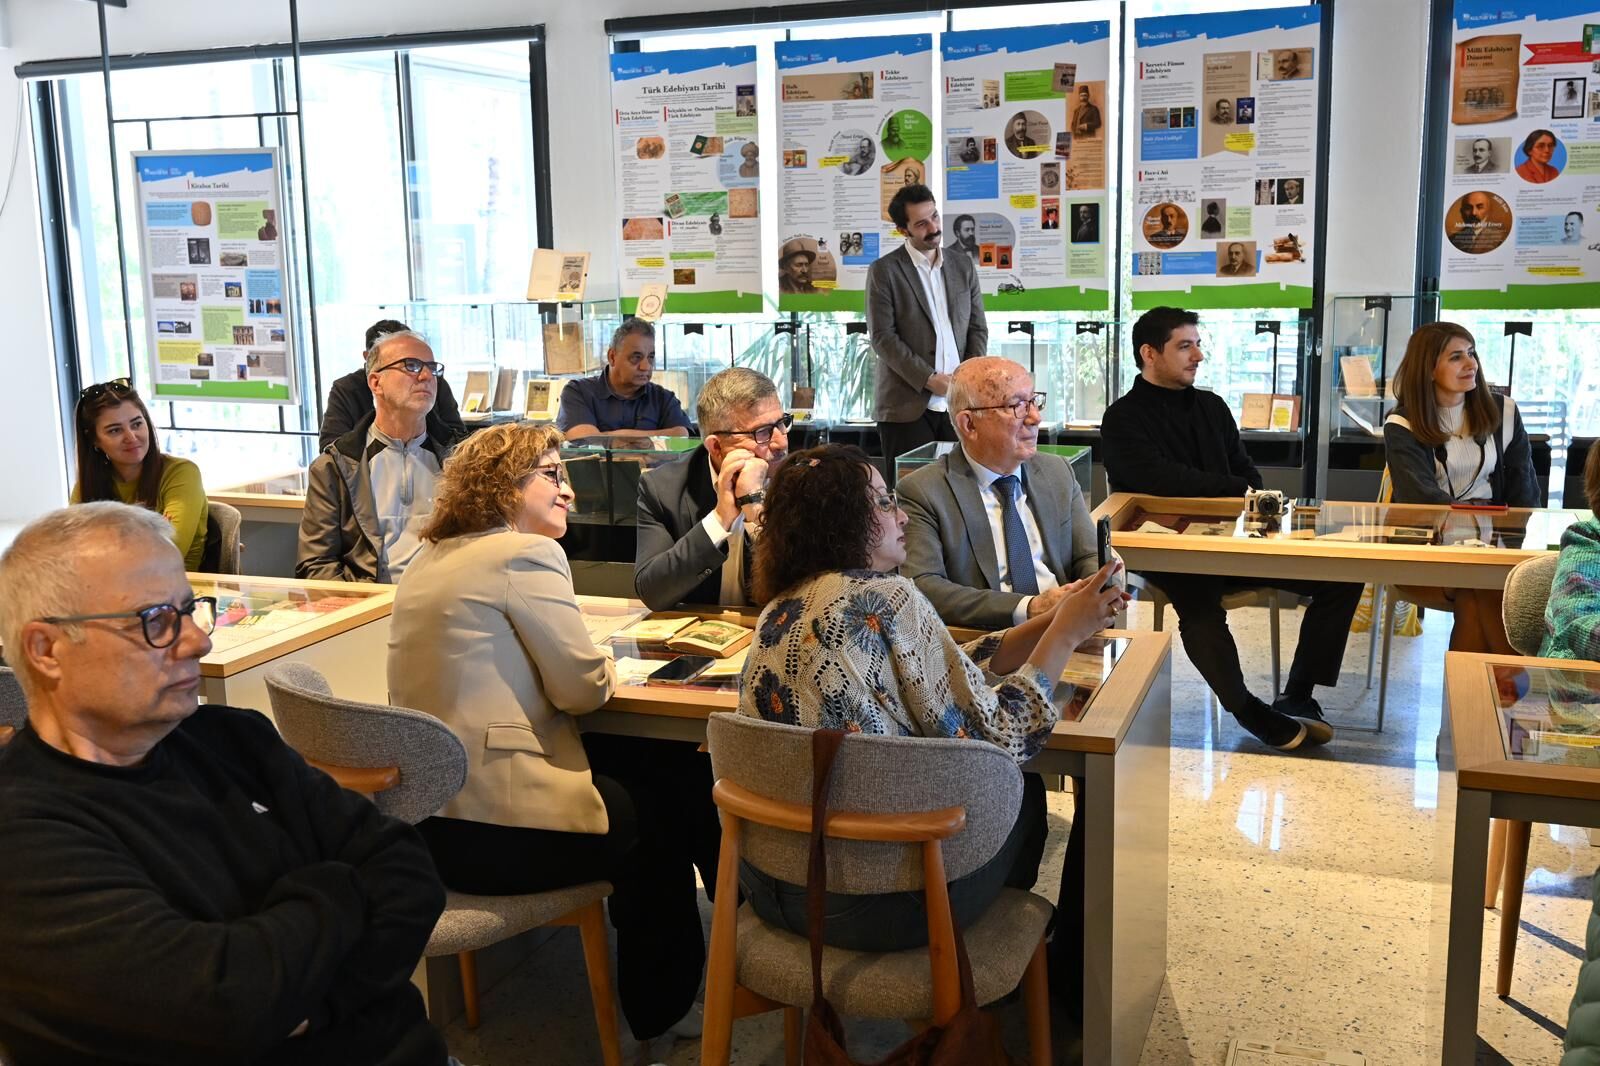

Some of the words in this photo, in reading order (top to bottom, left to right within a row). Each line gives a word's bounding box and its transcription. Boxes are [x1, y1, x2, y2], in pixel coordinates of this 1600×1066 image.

[1092, 25, 1099, 34] 3
[916, 37, 922, 46] 2
[642, 86, 662, 94] Türk
[663, 83, 700, 93] Edebiyatı
[702, 82, 726, 91] Tarihi
